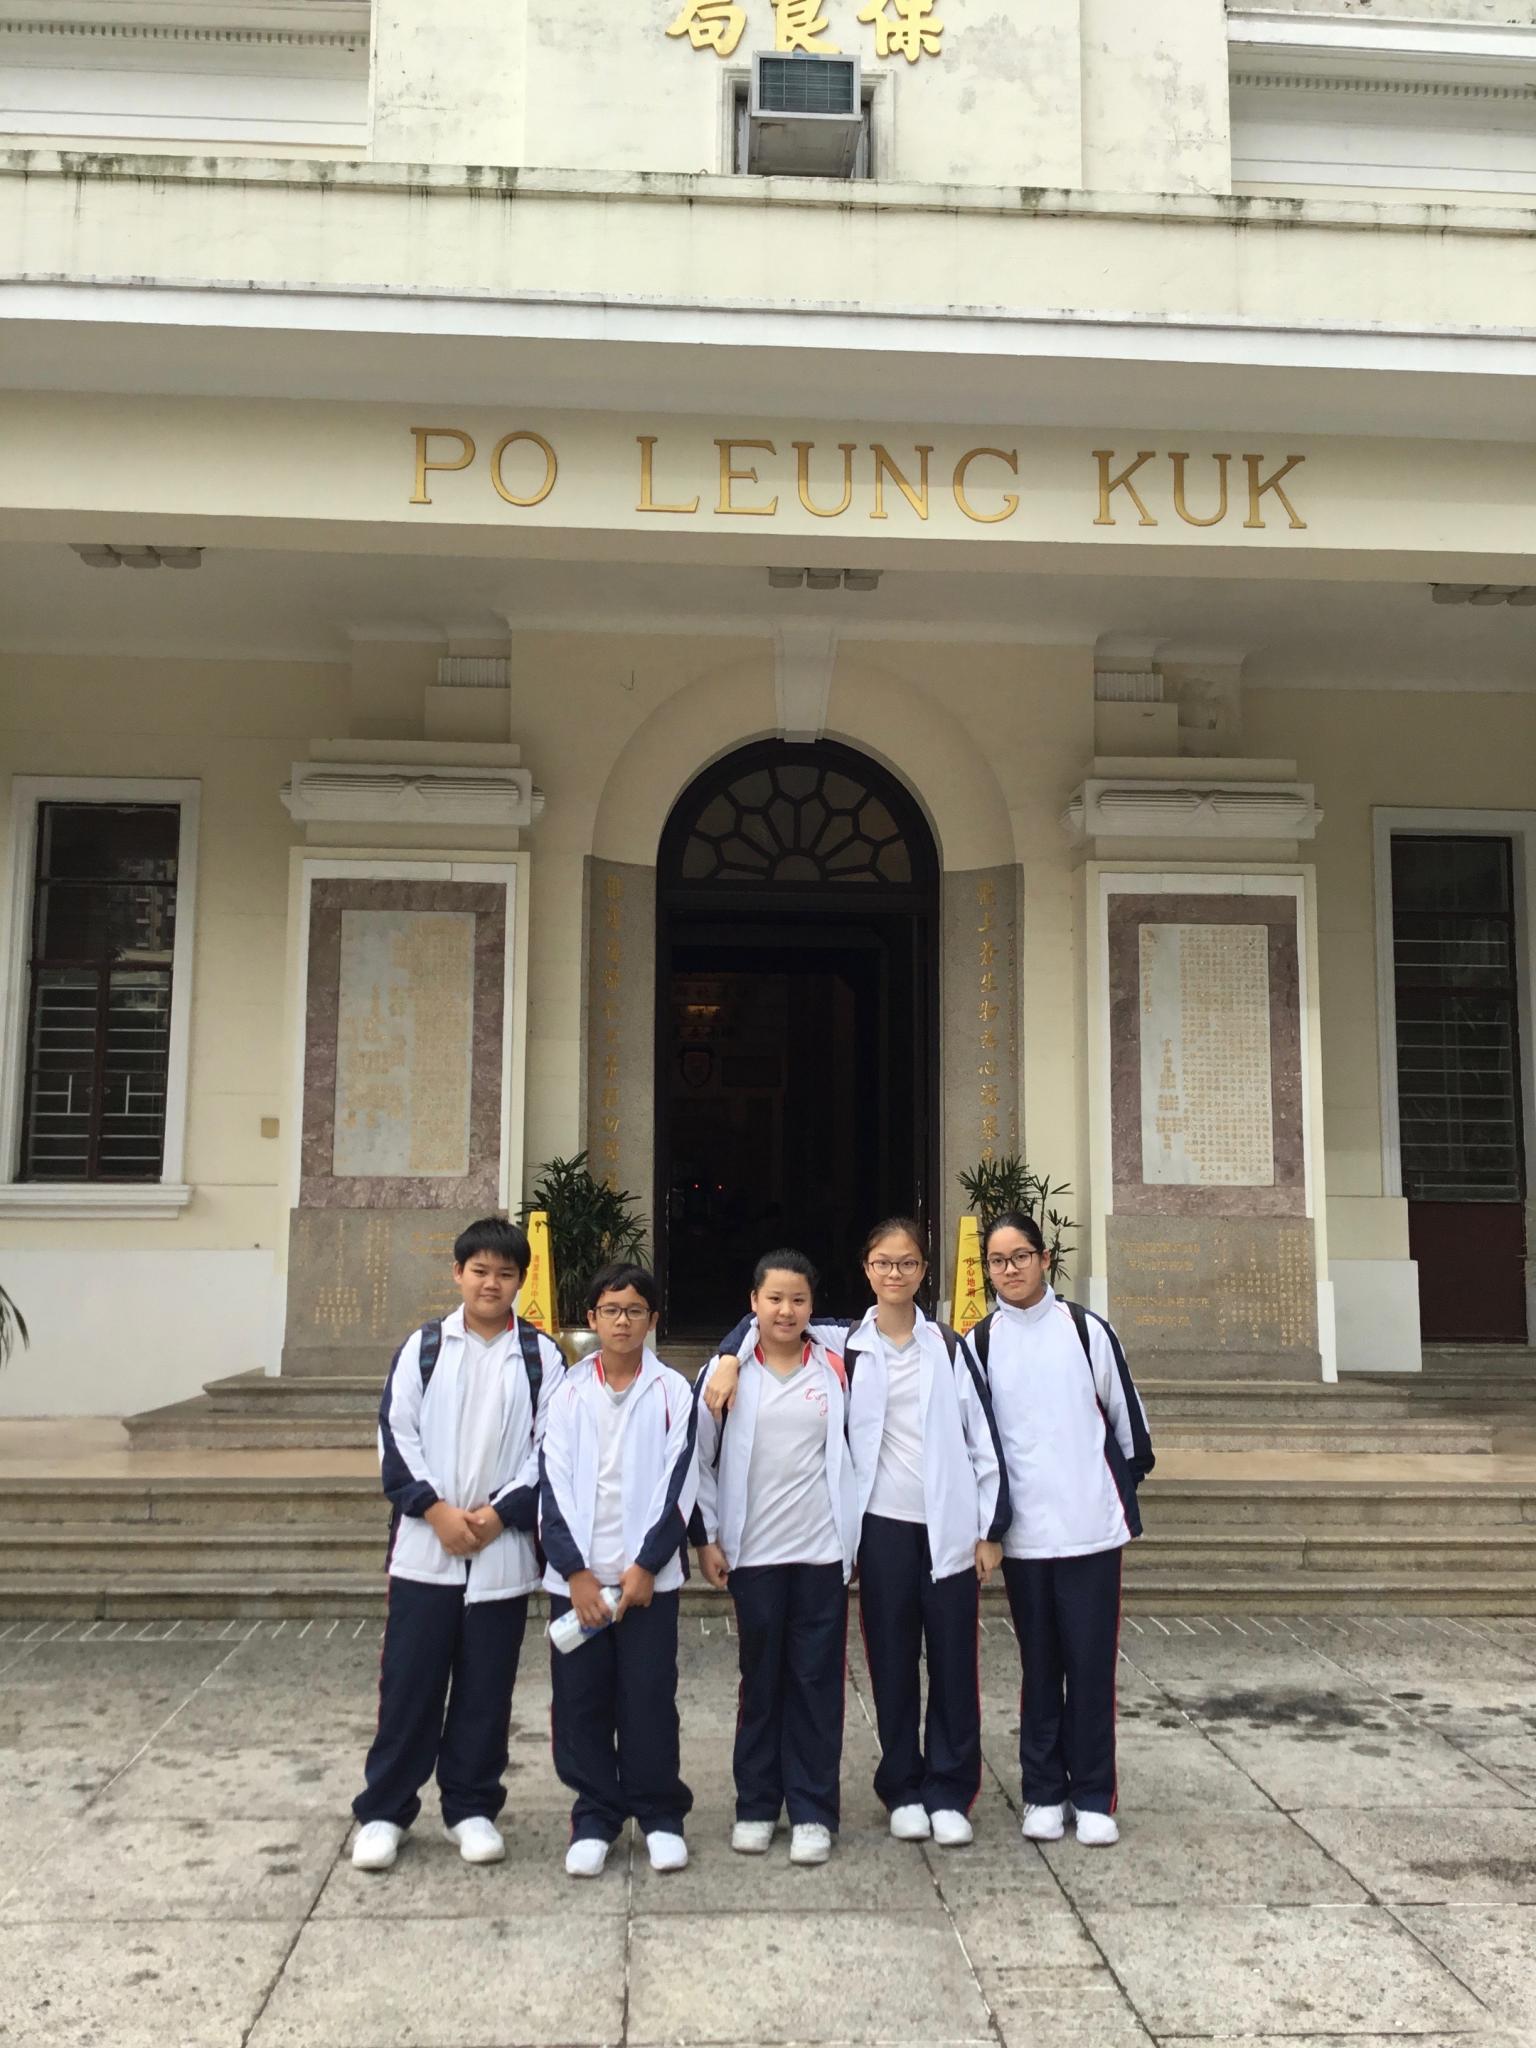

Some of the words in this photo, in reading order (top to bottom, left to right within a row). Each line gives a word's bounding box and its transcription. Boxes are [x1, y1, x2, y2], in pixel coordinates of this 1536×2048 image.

[409, 427, 558, 508] PO
[635, 436, 1020, 524] LEUNG
[1091, 449, 1308, 529] KUK
